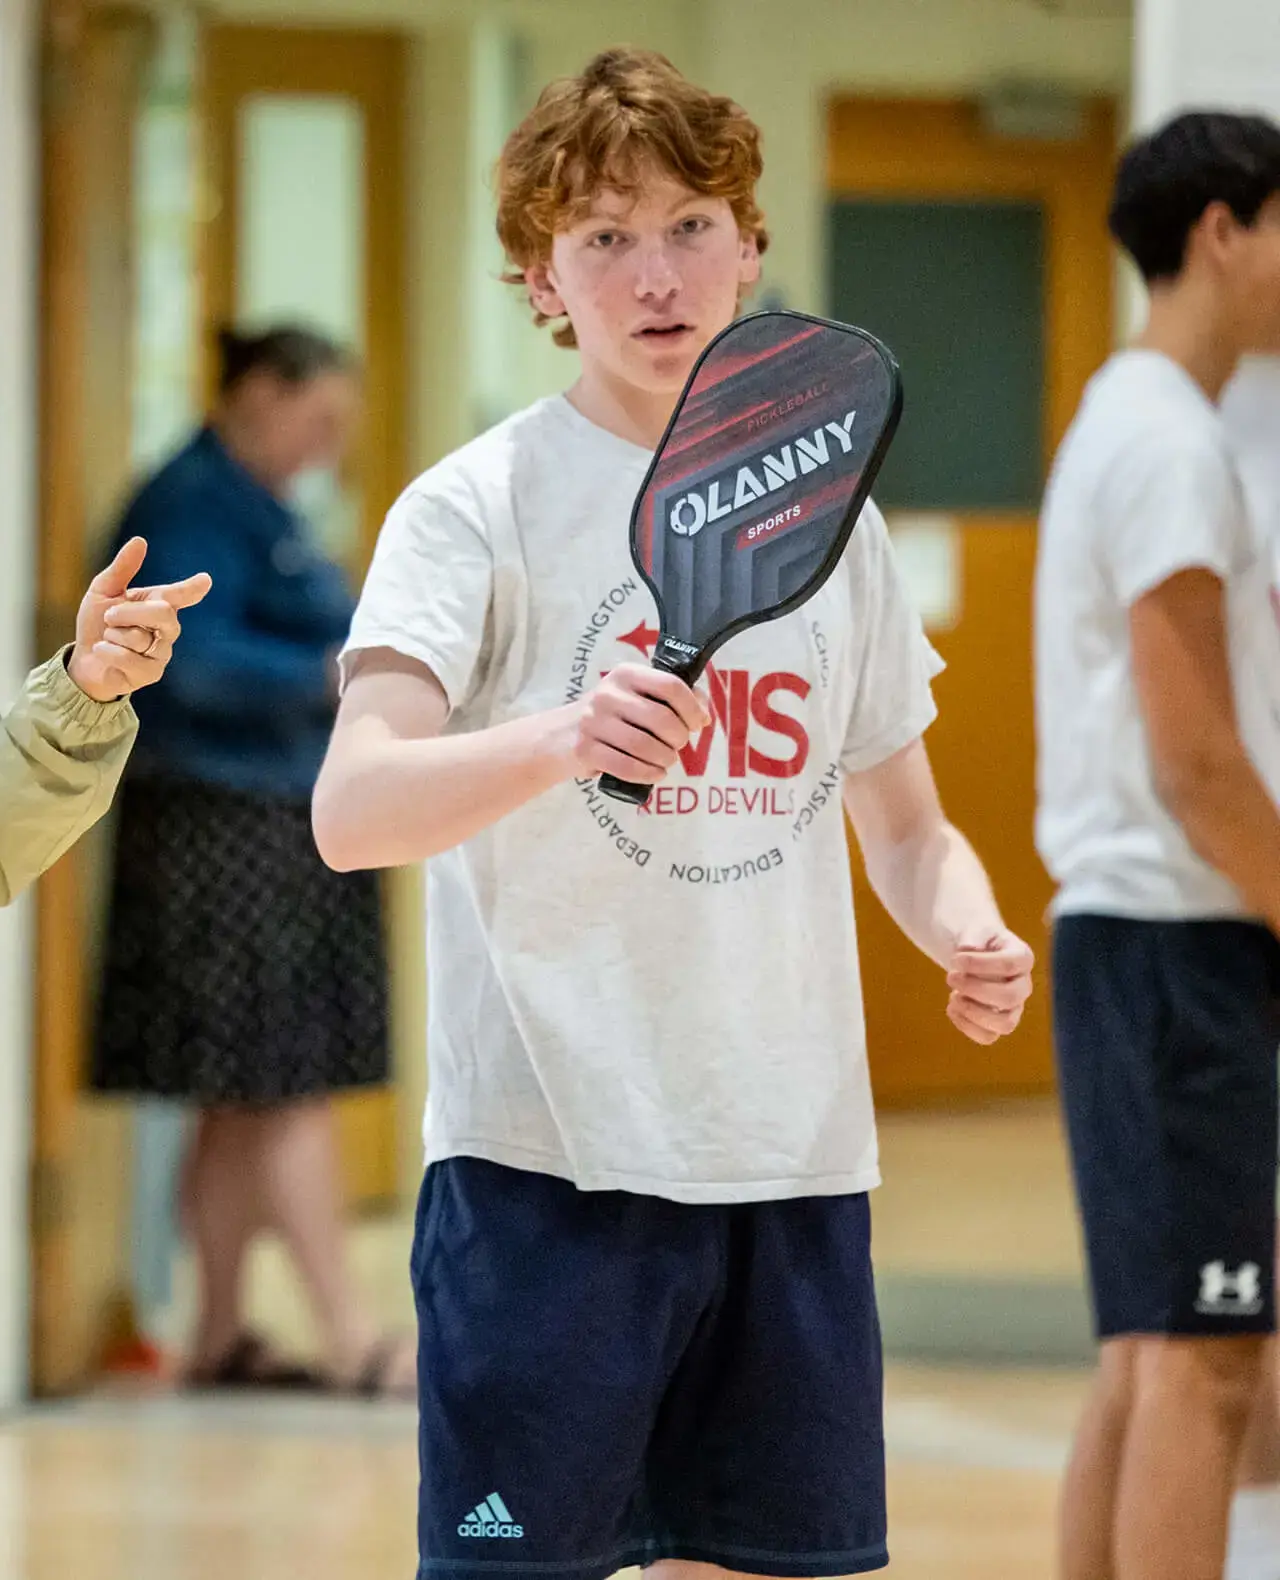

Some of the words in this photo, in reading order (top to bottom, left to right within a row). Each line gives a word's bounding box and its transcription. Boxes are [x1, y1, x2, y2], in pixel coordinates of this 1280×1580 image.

[747, 382, 830, 433] PICKLEBALL
[670, 410, 857, 537] OLANNY
[747, 504, 802, 541] SPORTS
[564, 576, 639, 704] WASHINGTON
[670, 847, 784, 884] EDUCATION
[457, 1520, 524, 1538] adidas
